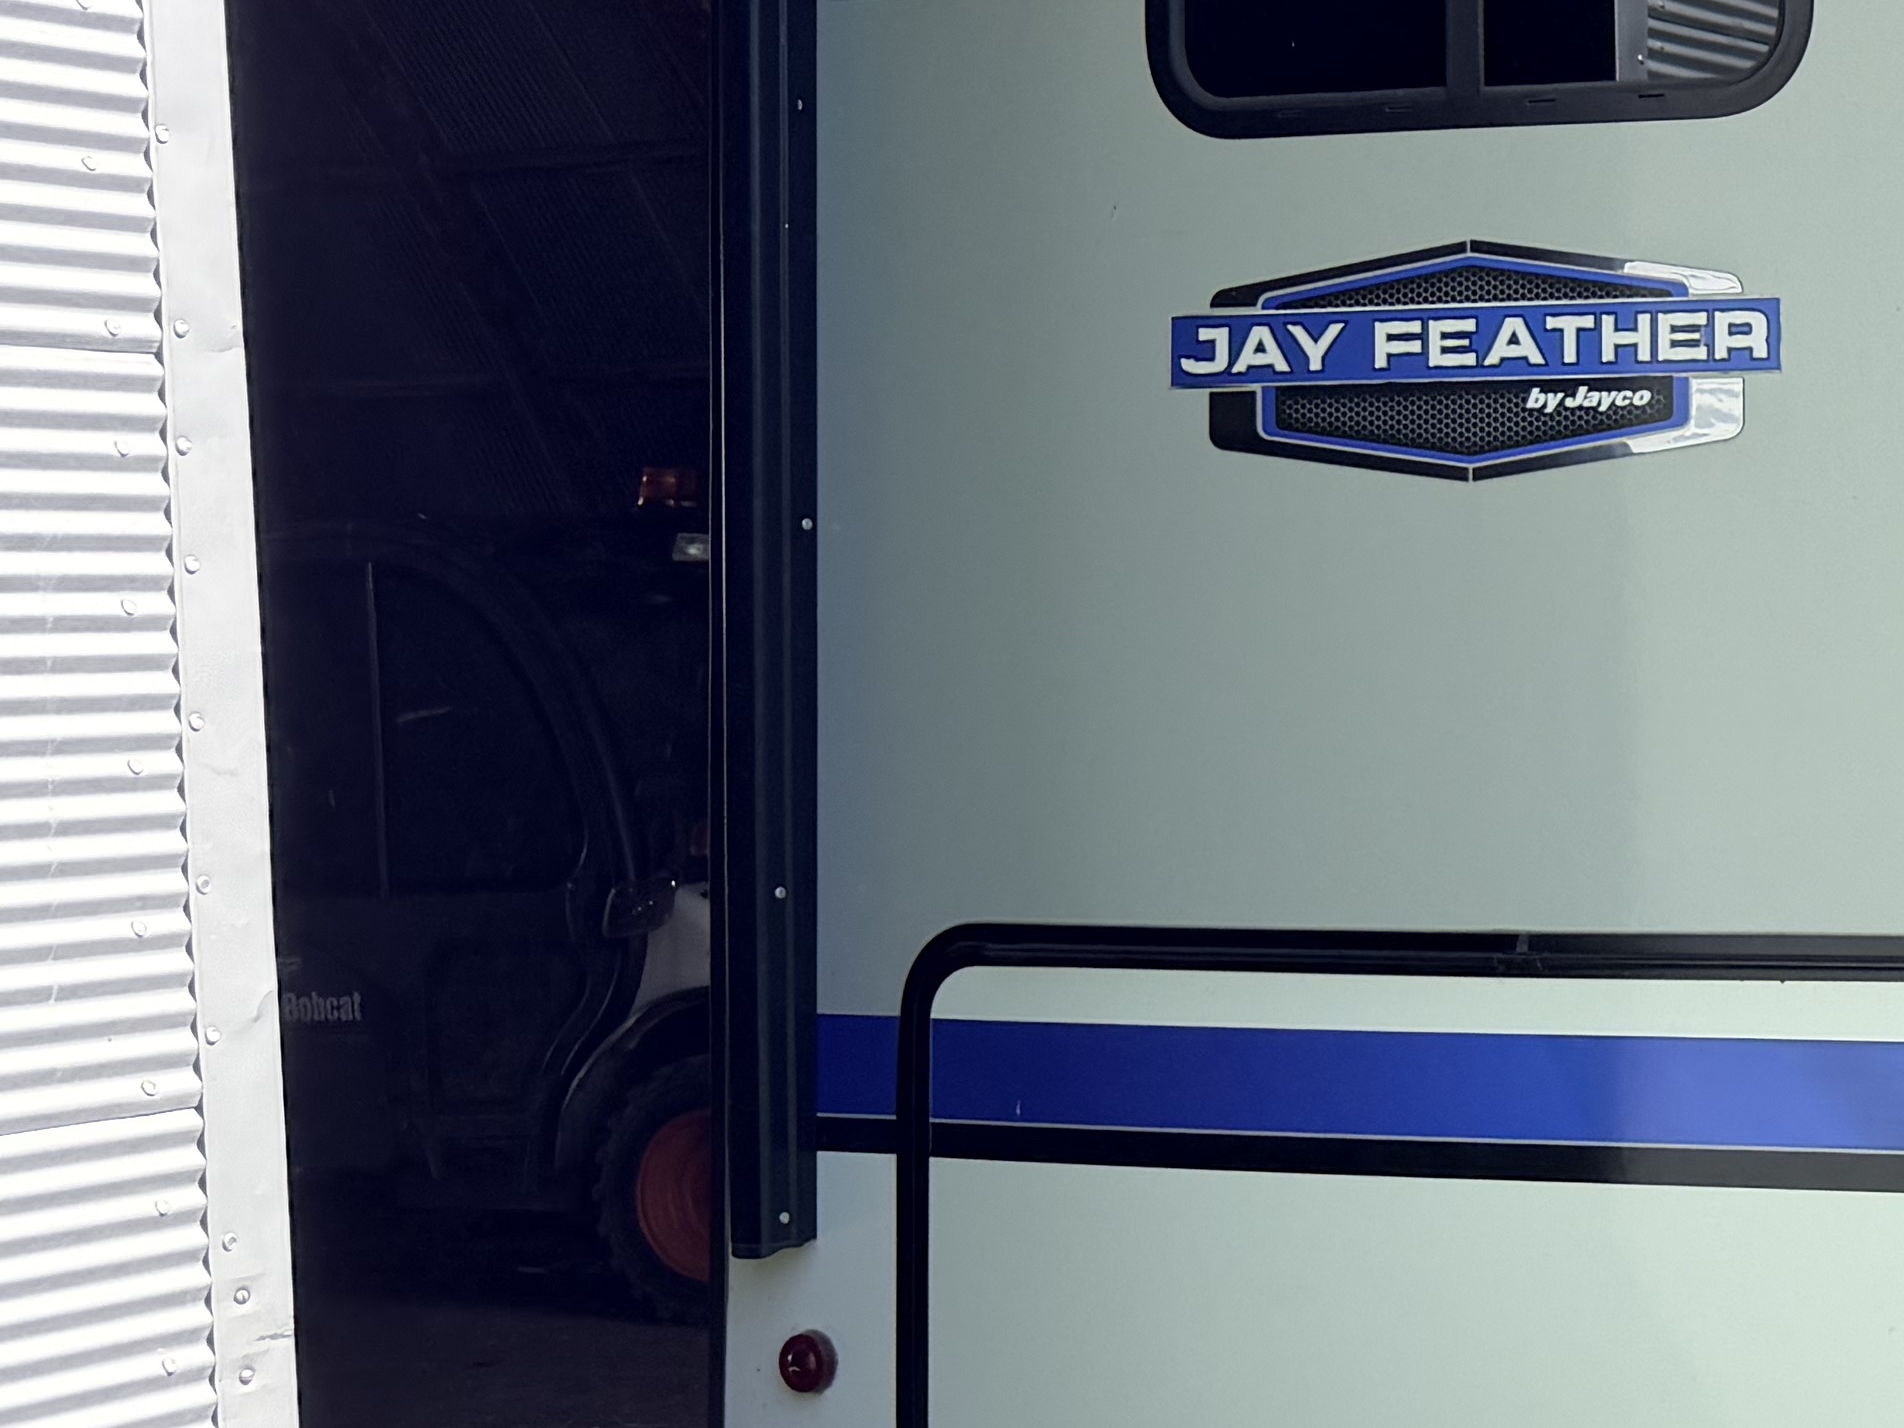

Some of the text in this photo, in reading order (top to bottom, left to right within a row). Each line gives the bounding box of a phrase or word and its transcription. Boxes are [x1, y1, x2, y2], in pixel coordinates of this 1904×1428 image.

[1179, 310, 1769, 375] JAY FEATHER
[1525, 385, 1652, 412] by Jayco
[281, 990, 362, 1023] Bobcat
